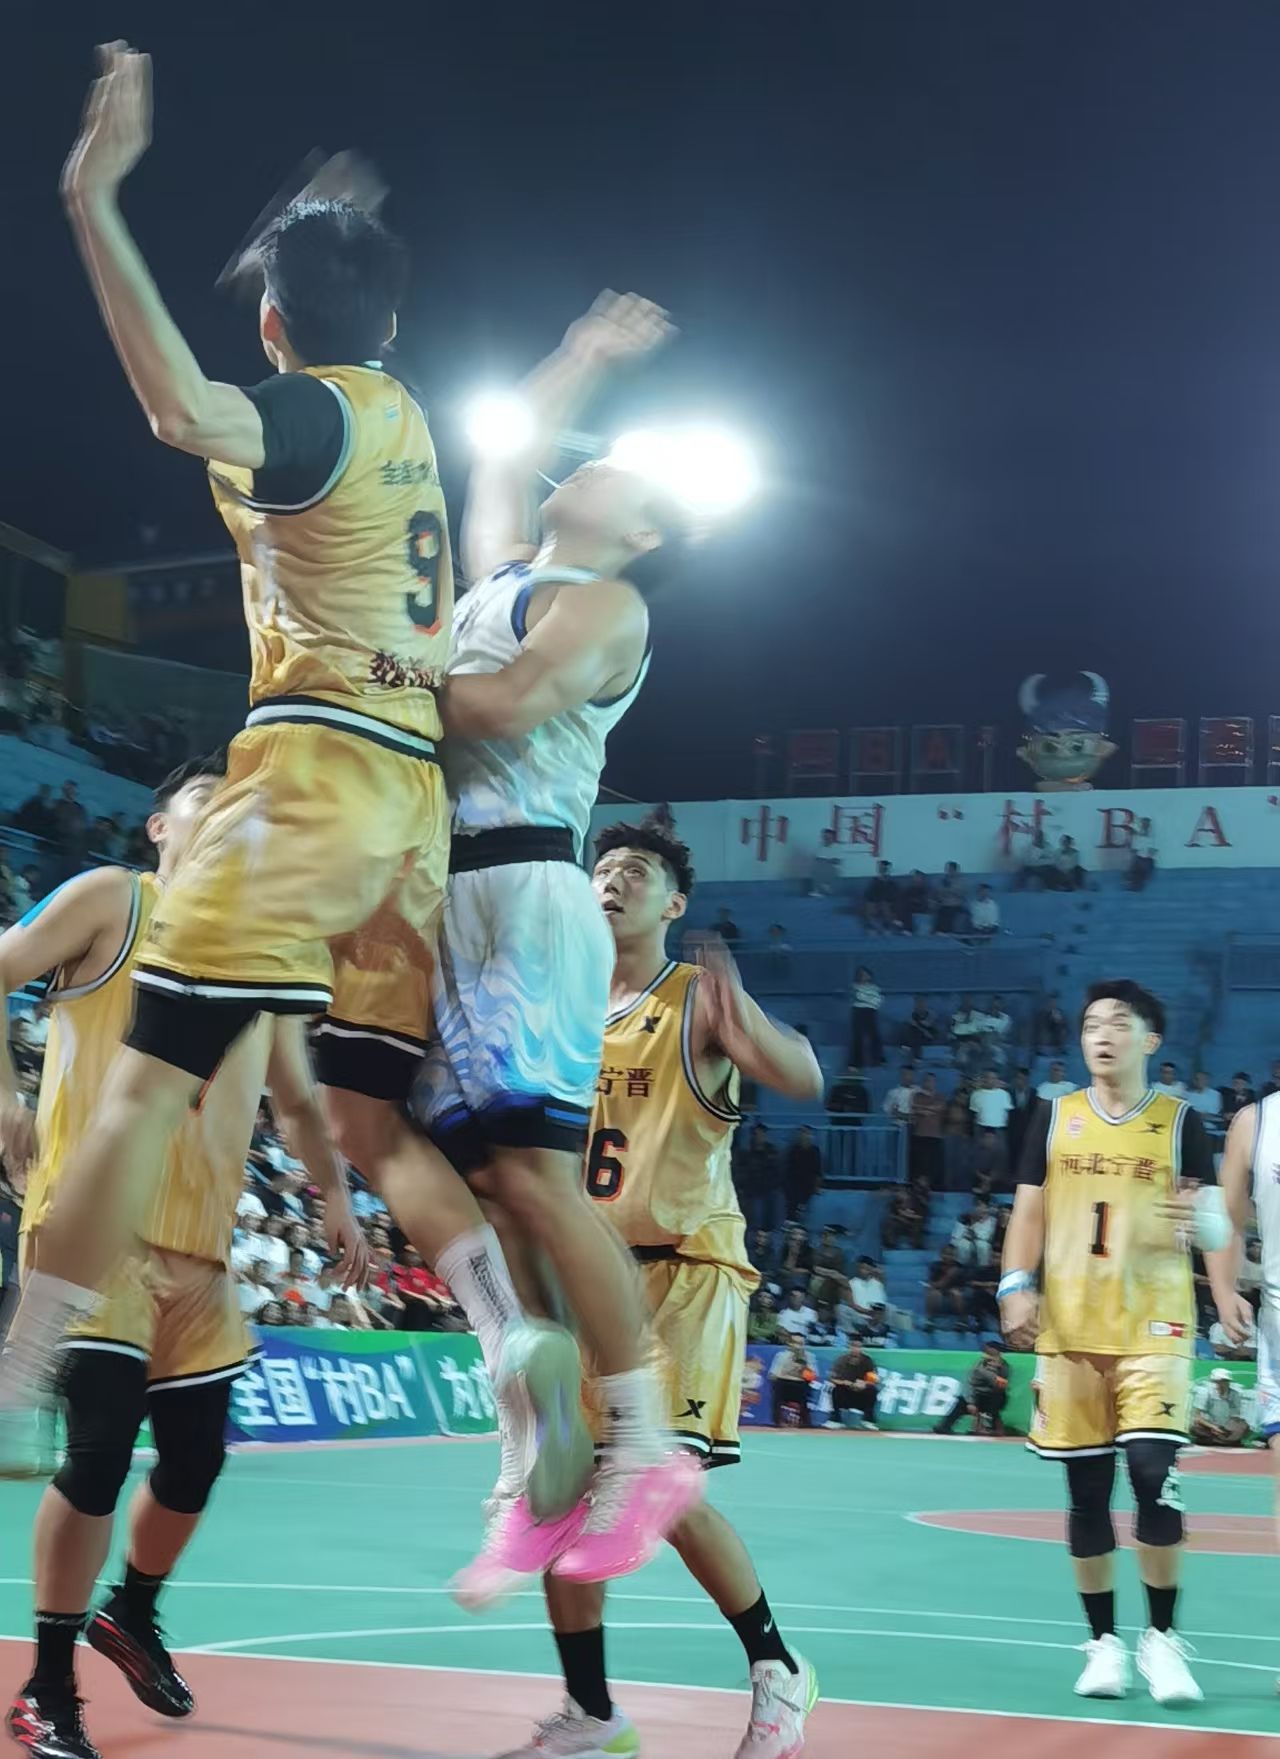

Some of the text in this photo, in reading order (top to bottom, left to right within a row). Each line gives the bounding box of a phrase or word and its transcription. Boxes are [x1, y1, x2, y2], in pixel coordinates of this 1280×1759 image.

[406, 510, 443, 638] 9
[586, 1128, 629, 1203] 6
[1090, 1201, 1112, 1258] 1
